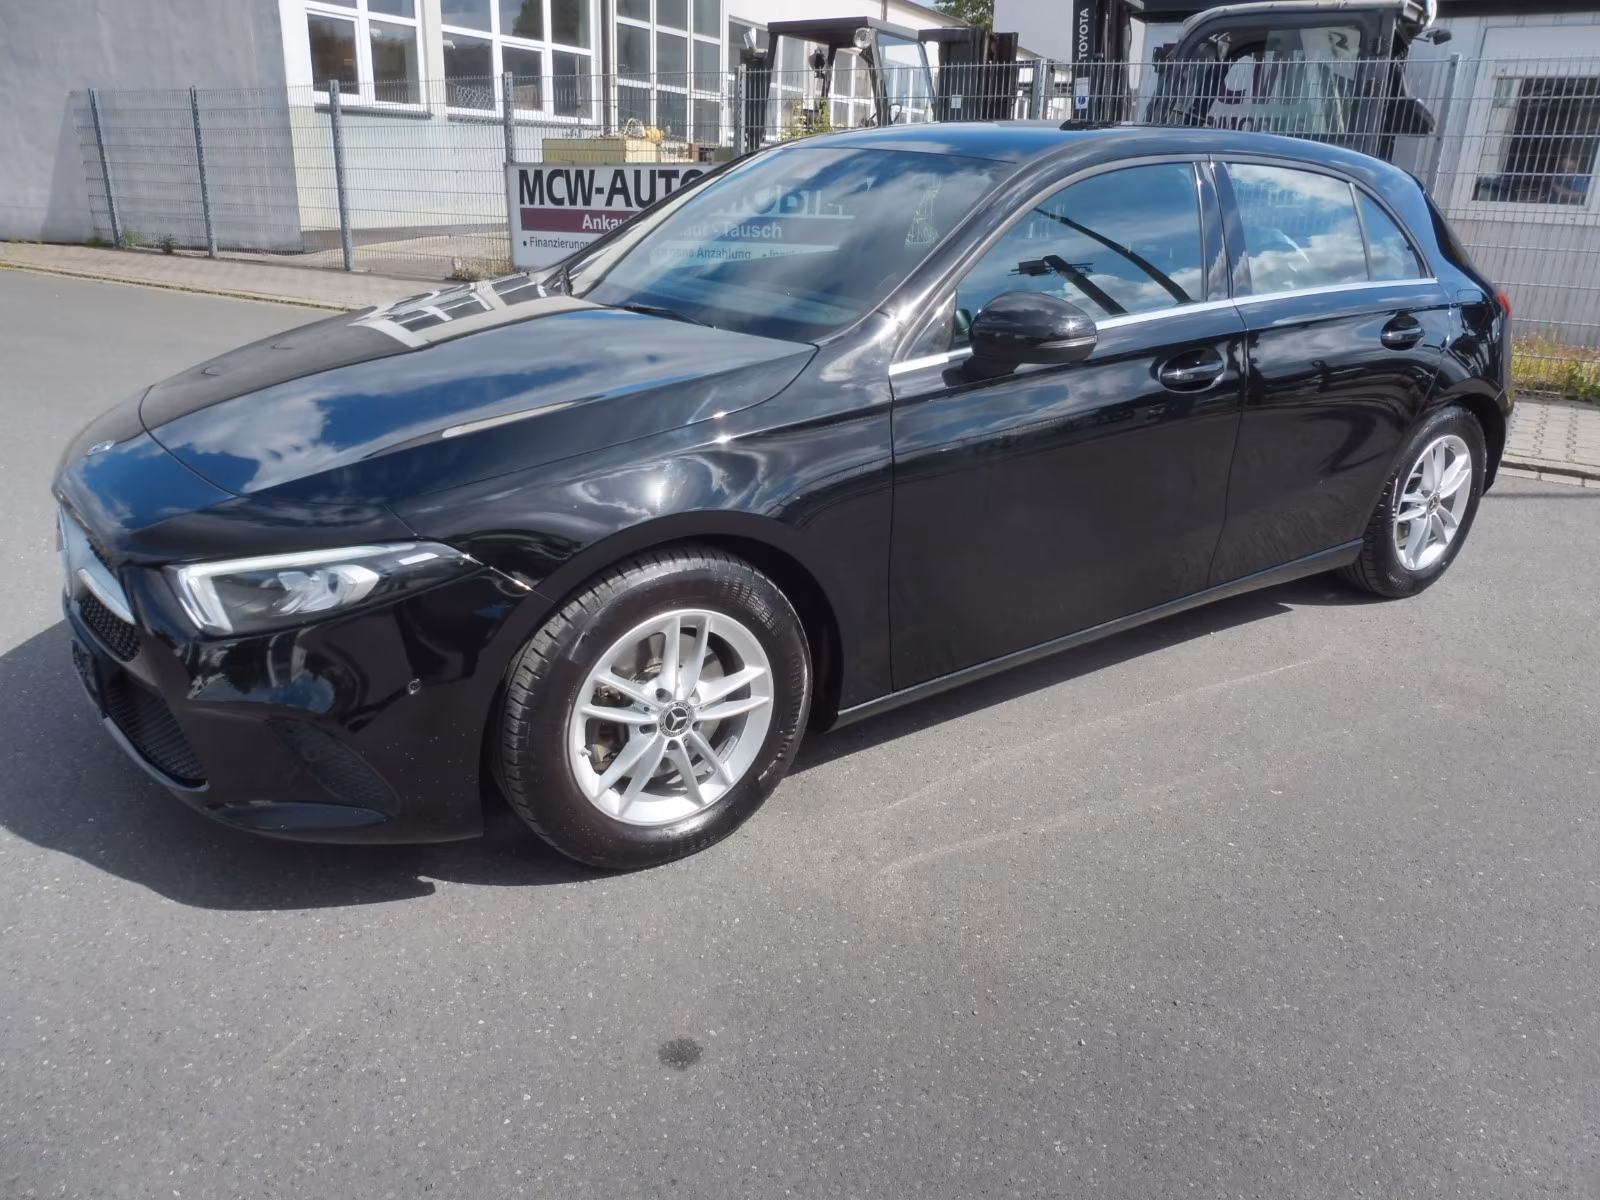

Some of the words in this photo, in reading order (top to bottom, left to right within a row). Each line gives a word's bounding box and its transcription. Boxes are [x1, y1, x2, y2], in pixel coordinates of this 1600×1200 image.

[1078, 7, 1089, 60] TOYOTA
[581, 213, 633, 231] Anka
[721, 221, 782, 239] Tausch
[697, 246, 751, 261] Anzahlung
